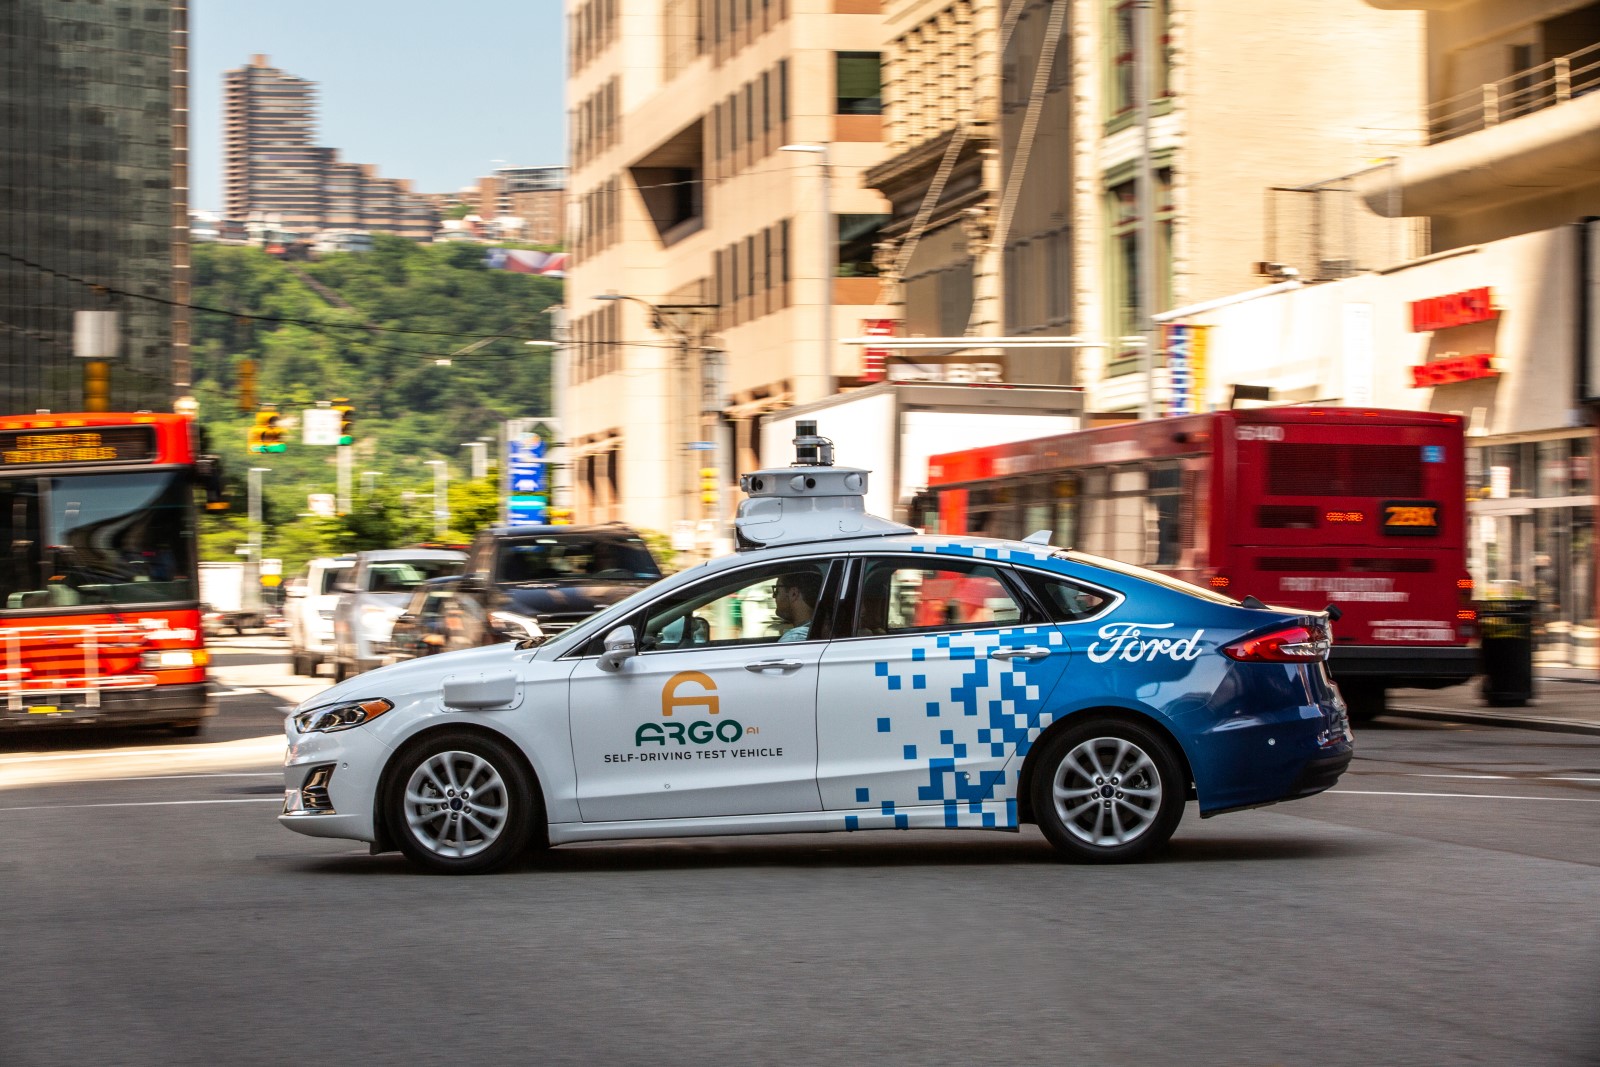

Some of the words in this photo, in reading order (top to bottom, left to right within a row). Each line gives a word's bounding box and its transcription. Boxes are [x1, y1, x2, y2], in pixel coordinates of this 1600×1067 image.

[1087, 622, 1204, 663] Ford
[635, 719, 743, 746] ARGO
[746, 726, 759, 735] AI
[604, 751, 692, 763] SELF-DRIVING
[696, 749, 727, 760] TEST
[731, 747, 783, 758] VEHICLE
